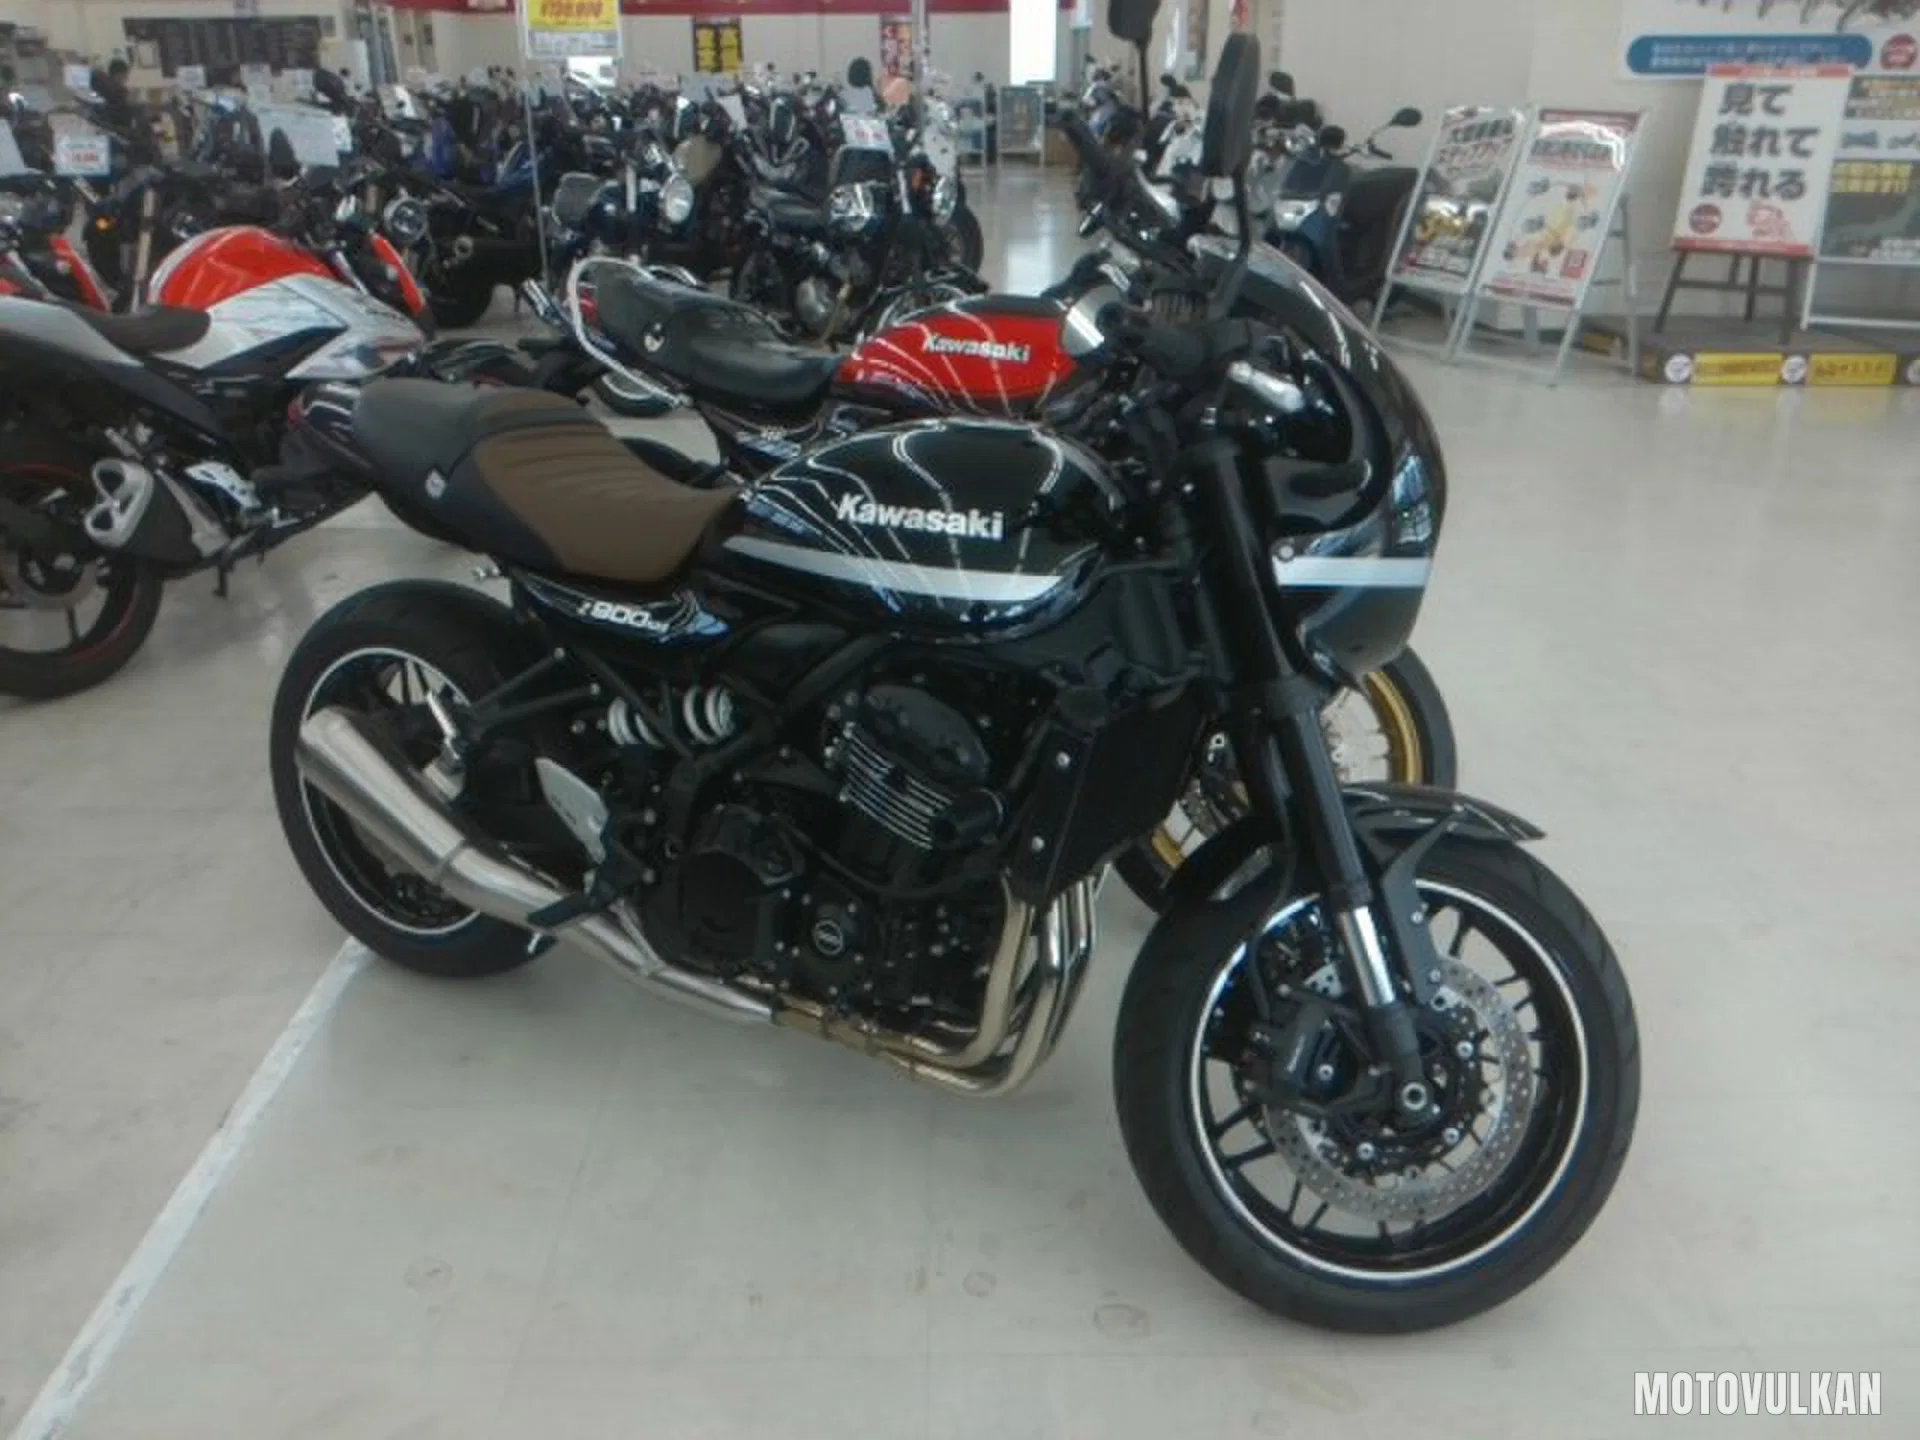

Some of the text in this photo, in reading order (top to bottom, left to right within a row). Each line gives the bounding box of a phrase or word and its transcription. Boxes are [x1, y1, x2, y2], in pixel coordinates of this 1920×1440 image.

[1719, 83, 1794, 117] 見て
[1709, 121, 1821, 159] 触れて
[922, 332, 1031, 364] Kawasaki
[837, 492, 1005, 541] Kawasaki
